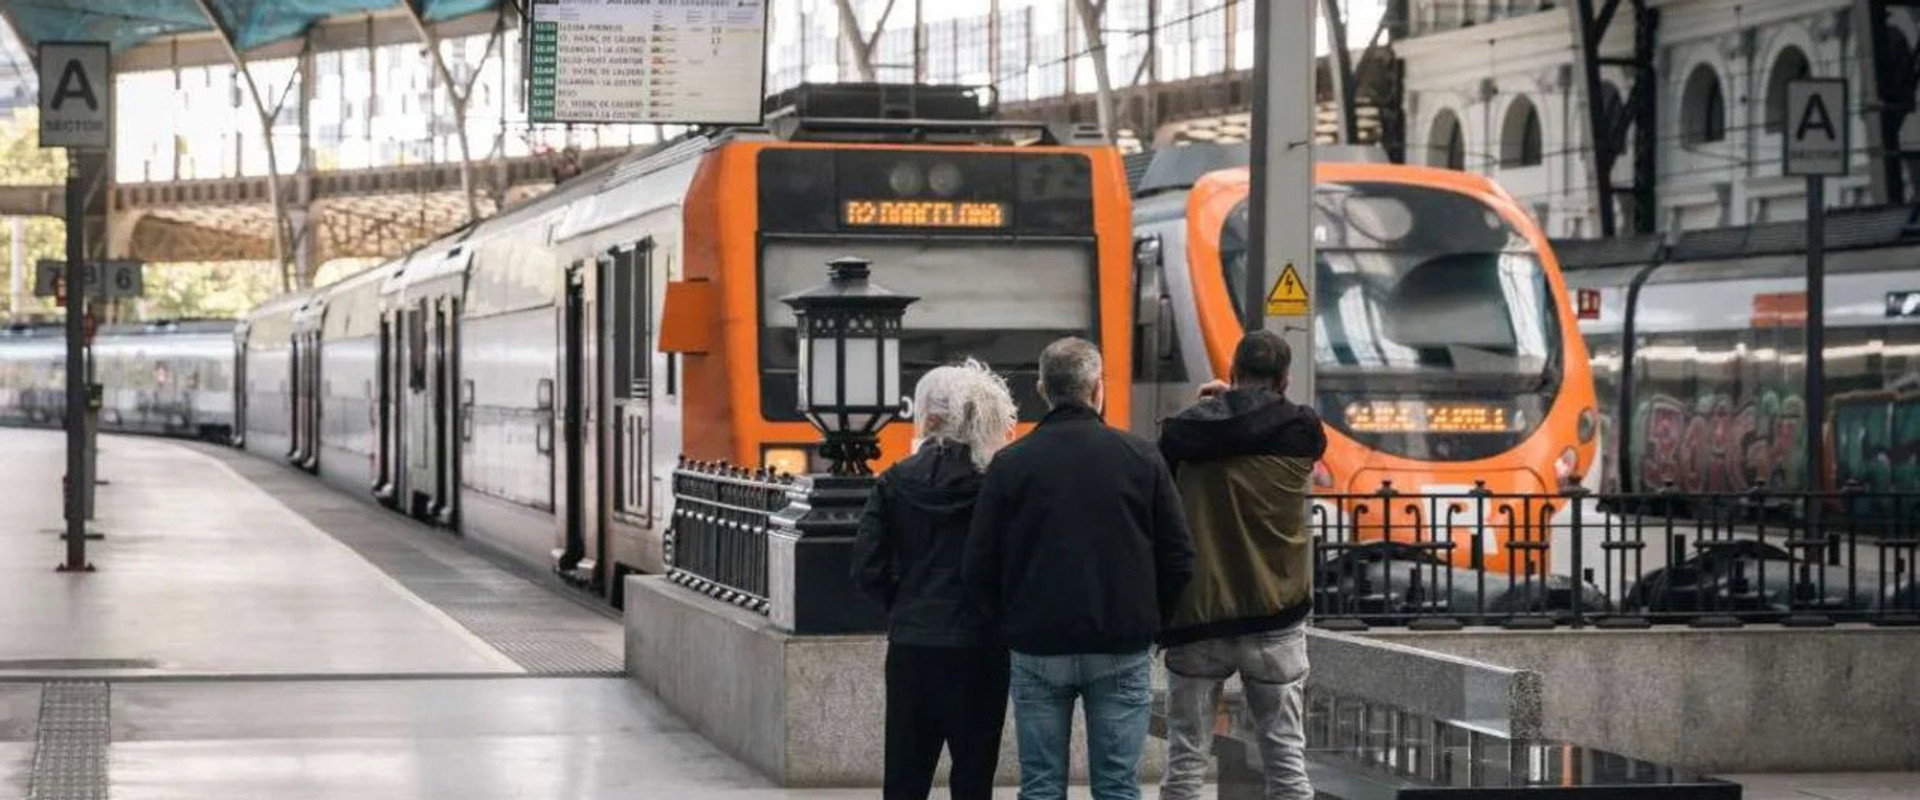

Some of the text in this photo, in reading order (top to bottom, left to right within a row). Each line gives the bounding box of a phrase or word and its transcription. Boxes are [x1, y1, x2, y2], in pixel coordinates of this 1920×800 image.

[51, 58, 98, 111] A
[1797, 93, 1835, 141] A
[115, 266, 131, 290] 6
